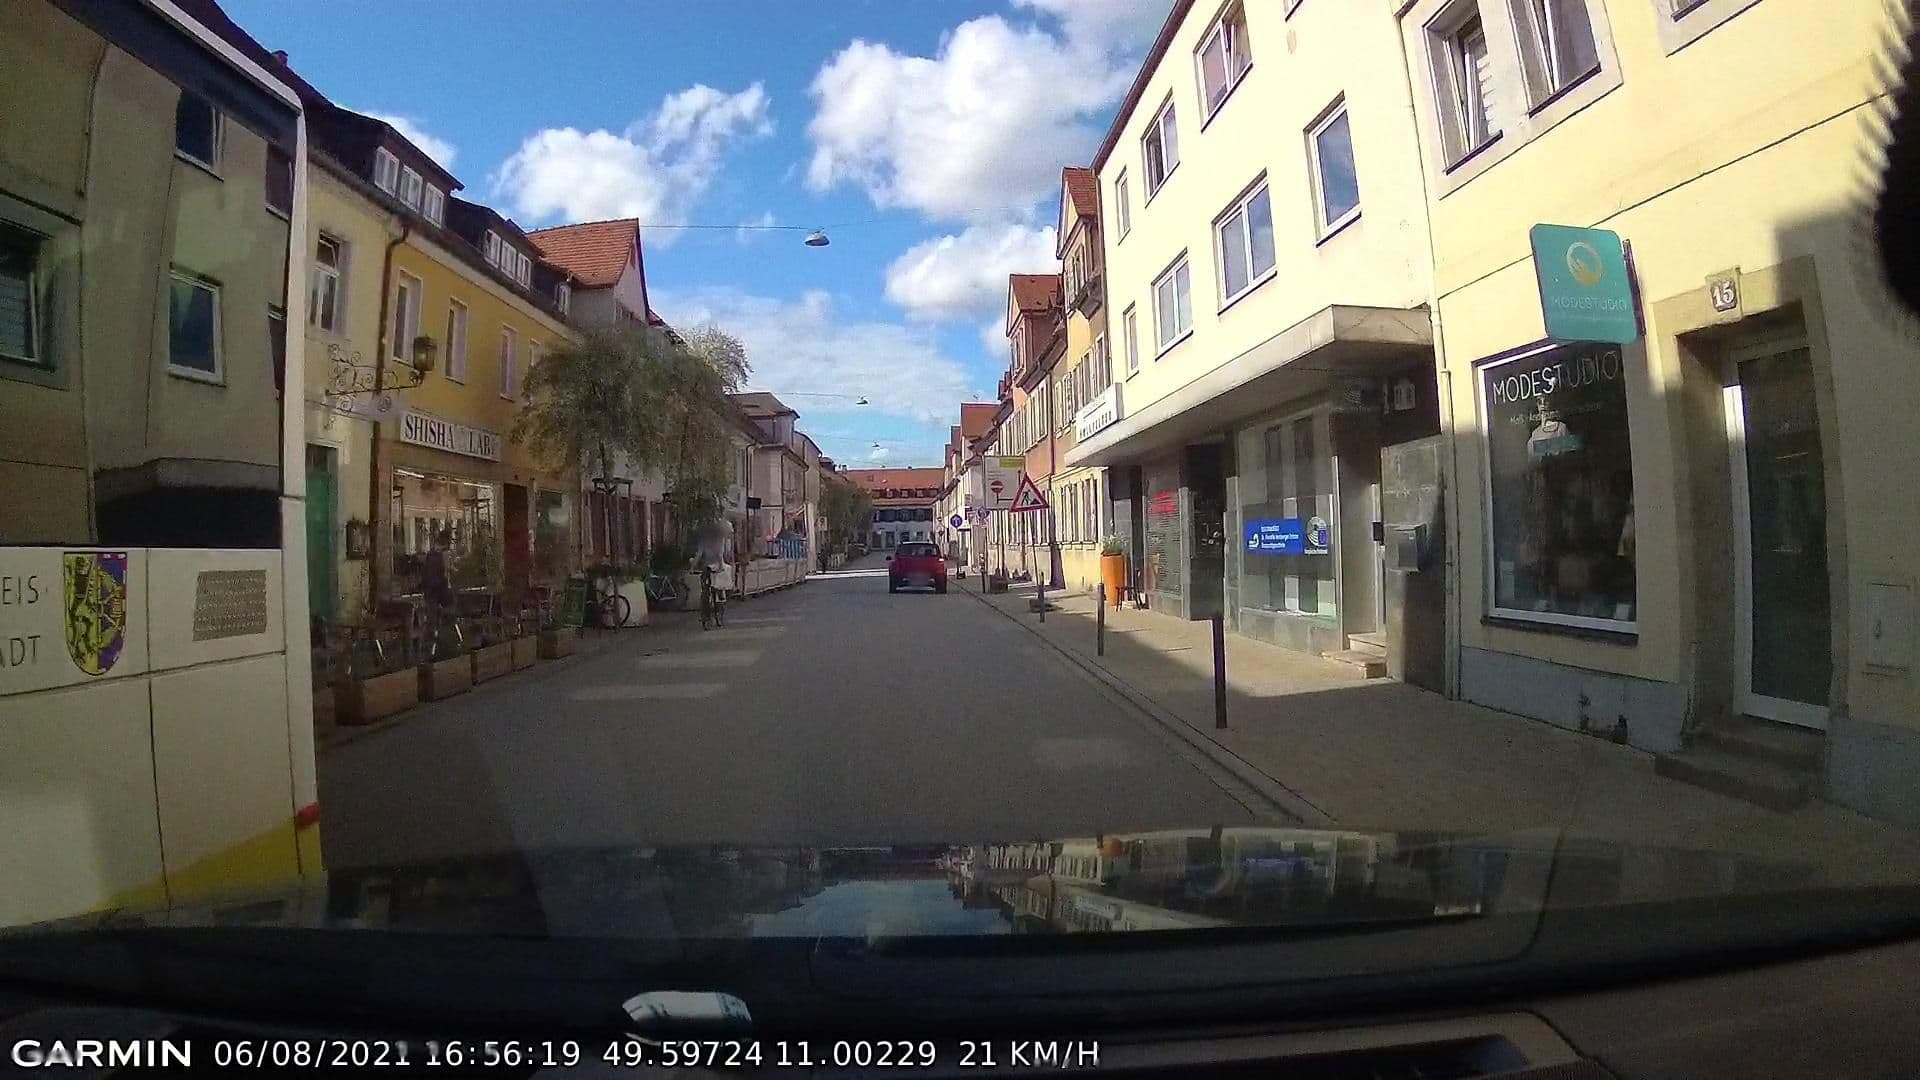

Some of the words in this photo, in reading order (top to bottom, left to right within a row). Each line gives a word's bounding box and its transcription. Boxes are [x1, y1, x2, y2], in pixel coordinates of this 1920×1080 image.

[1712, 280, 1735, 308] 15
[1492, 350, 1619, 405] MODESTUDIO
[404, 413, 456, 450] SHISHA
